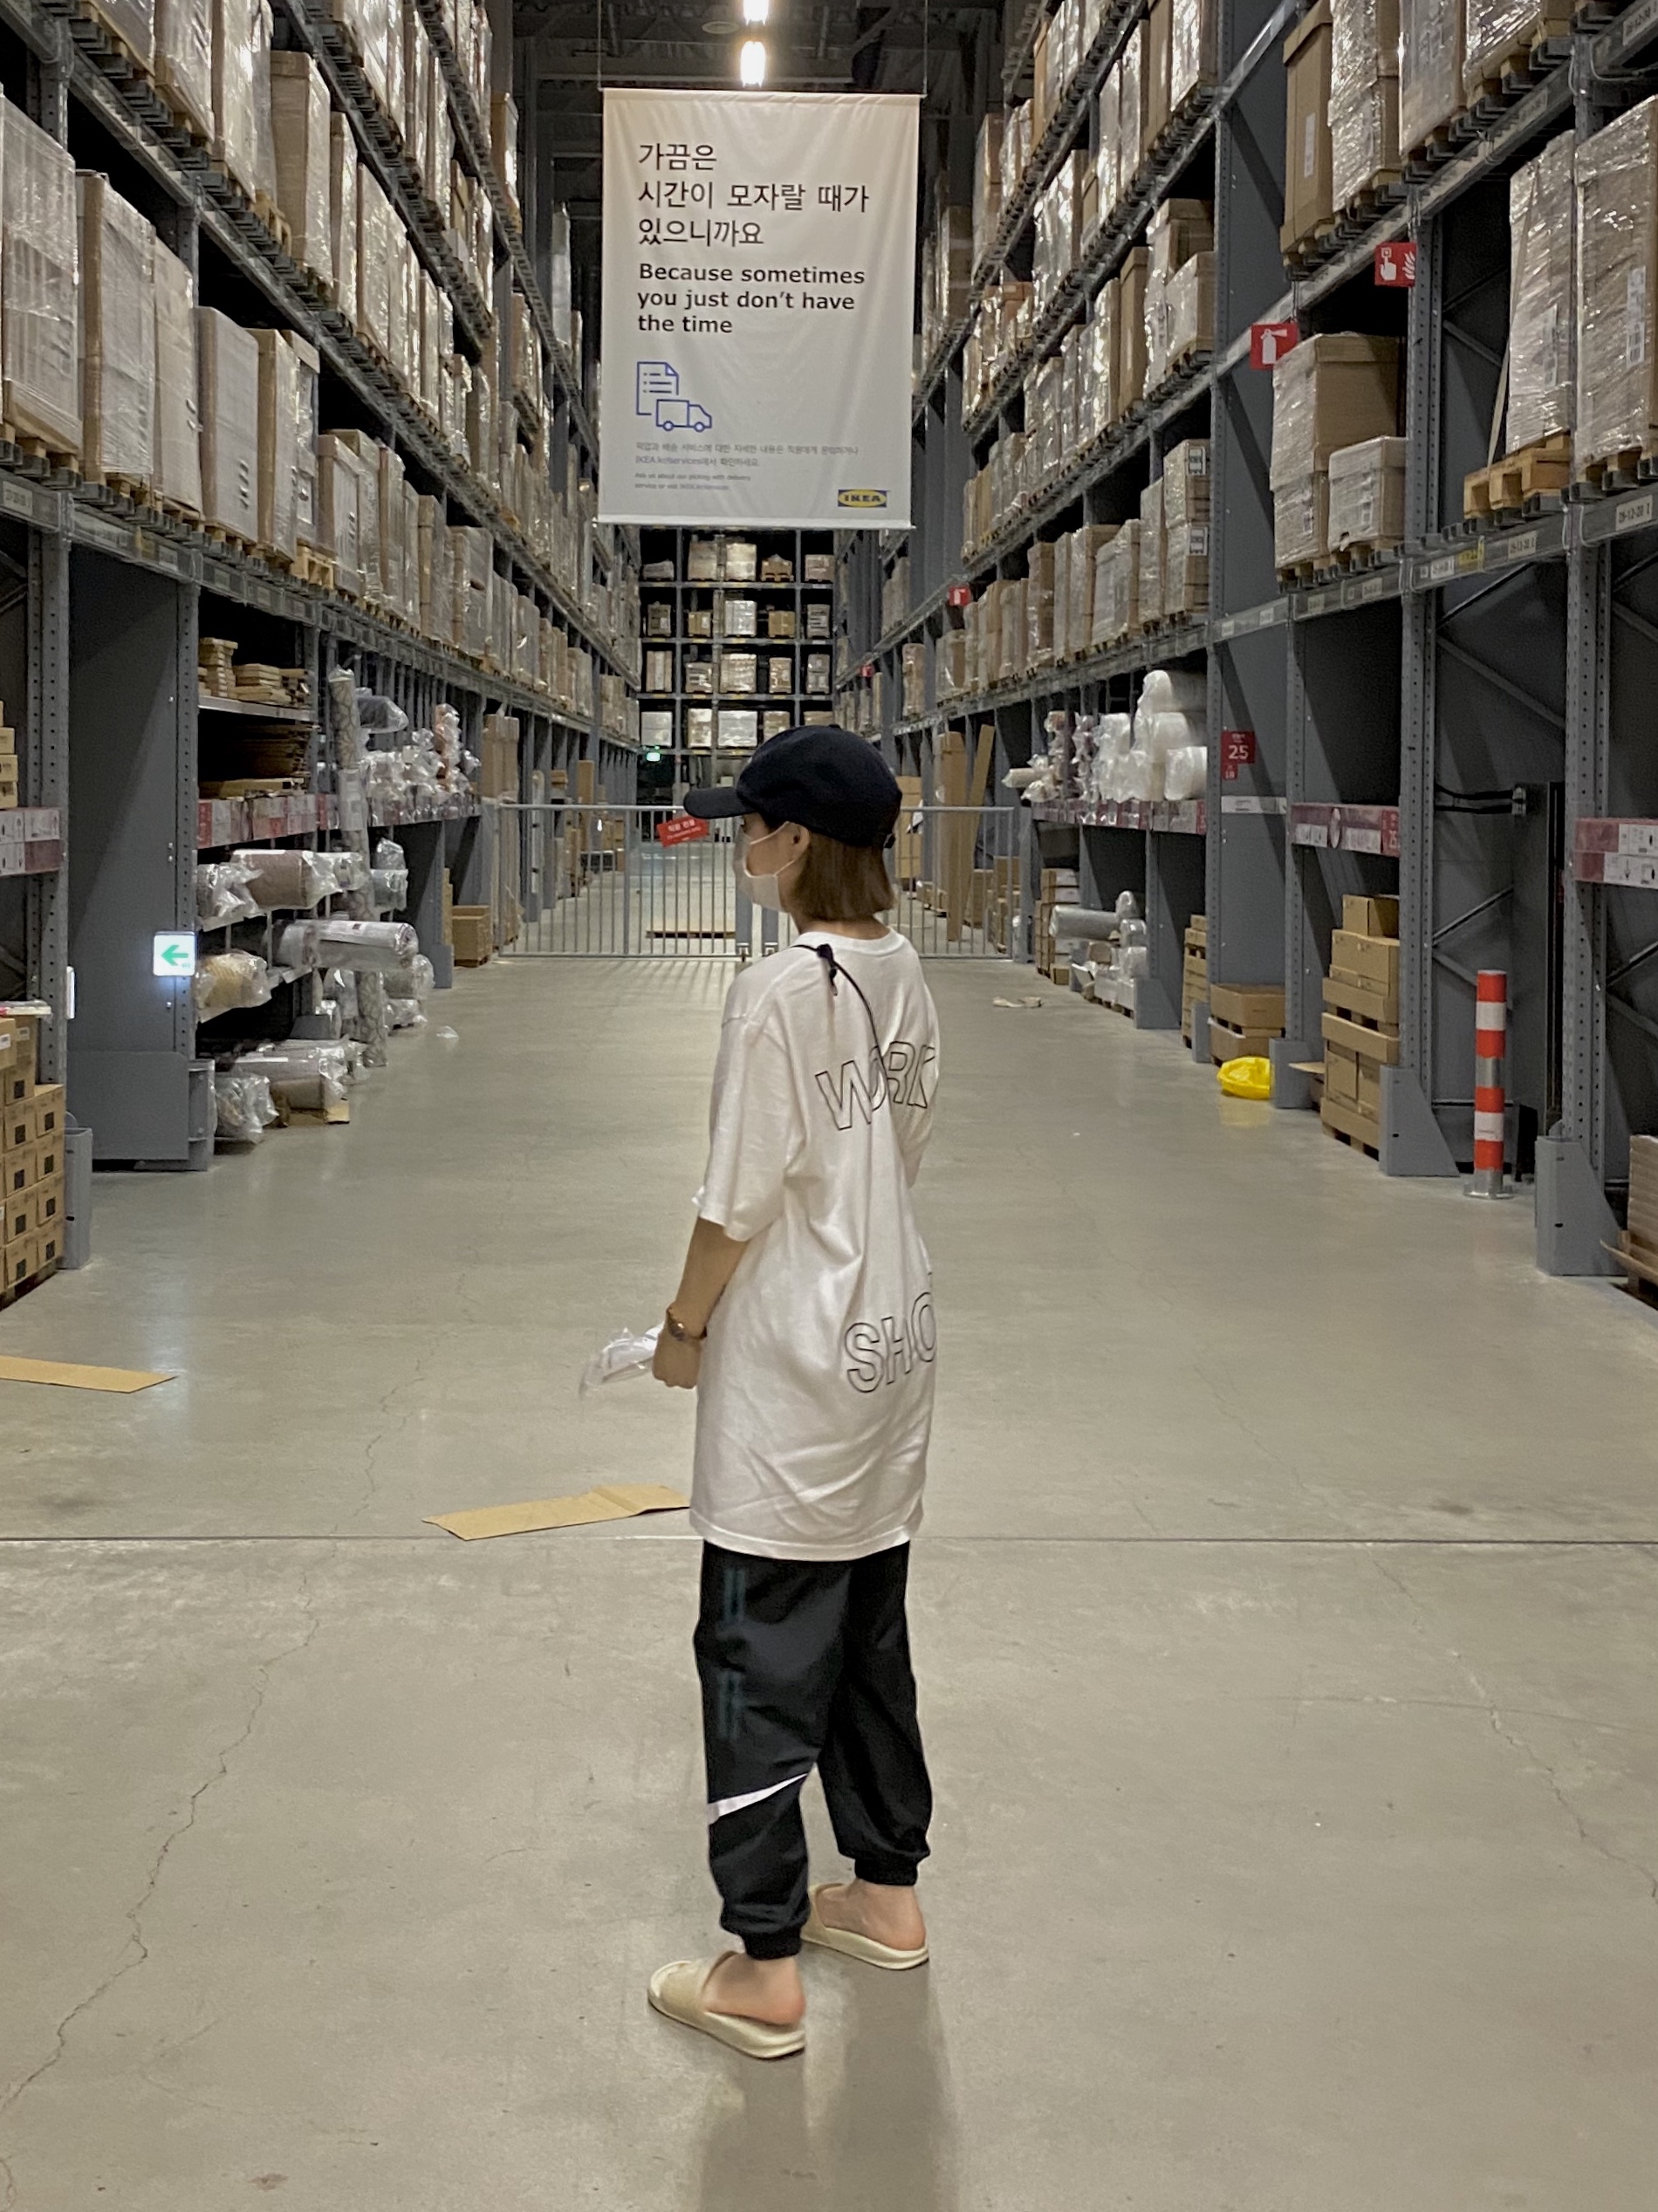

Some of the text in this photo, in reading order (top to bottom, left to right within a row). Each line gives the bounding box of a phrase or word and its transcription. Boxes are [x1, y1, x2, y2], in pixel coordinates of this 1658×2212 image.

[638, 142, 718, 172] 가끔은
[637, 180, 870, 214] 시간이 모자랄 때가
[638, 217, 764, 248] 있으니까요
[639, 263, 866, 285] Because sometimes
[637, 289, 856, 311] you just don't have
[637, 314, 734, 335] the time
[1229, 744, 1249, 760] 25
